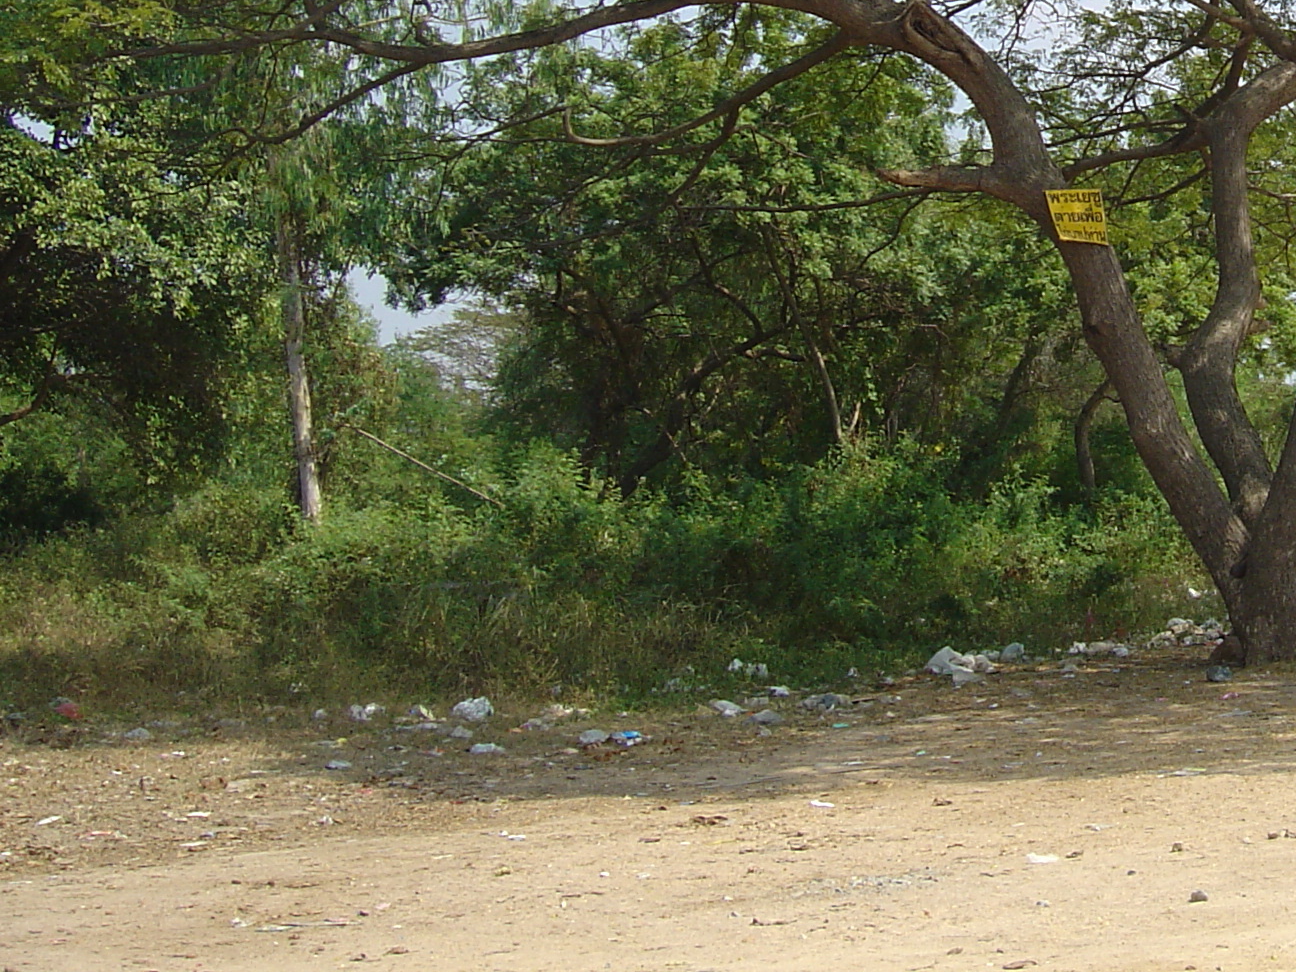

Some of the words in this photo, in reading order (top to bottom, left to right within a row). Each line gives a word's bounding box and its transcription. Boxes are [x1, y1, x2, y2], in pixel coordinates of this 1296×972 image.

[1048, 192, 1102, 208] พระเยซู
[1054, 204, 1103, 222] ตายเพื่อ
